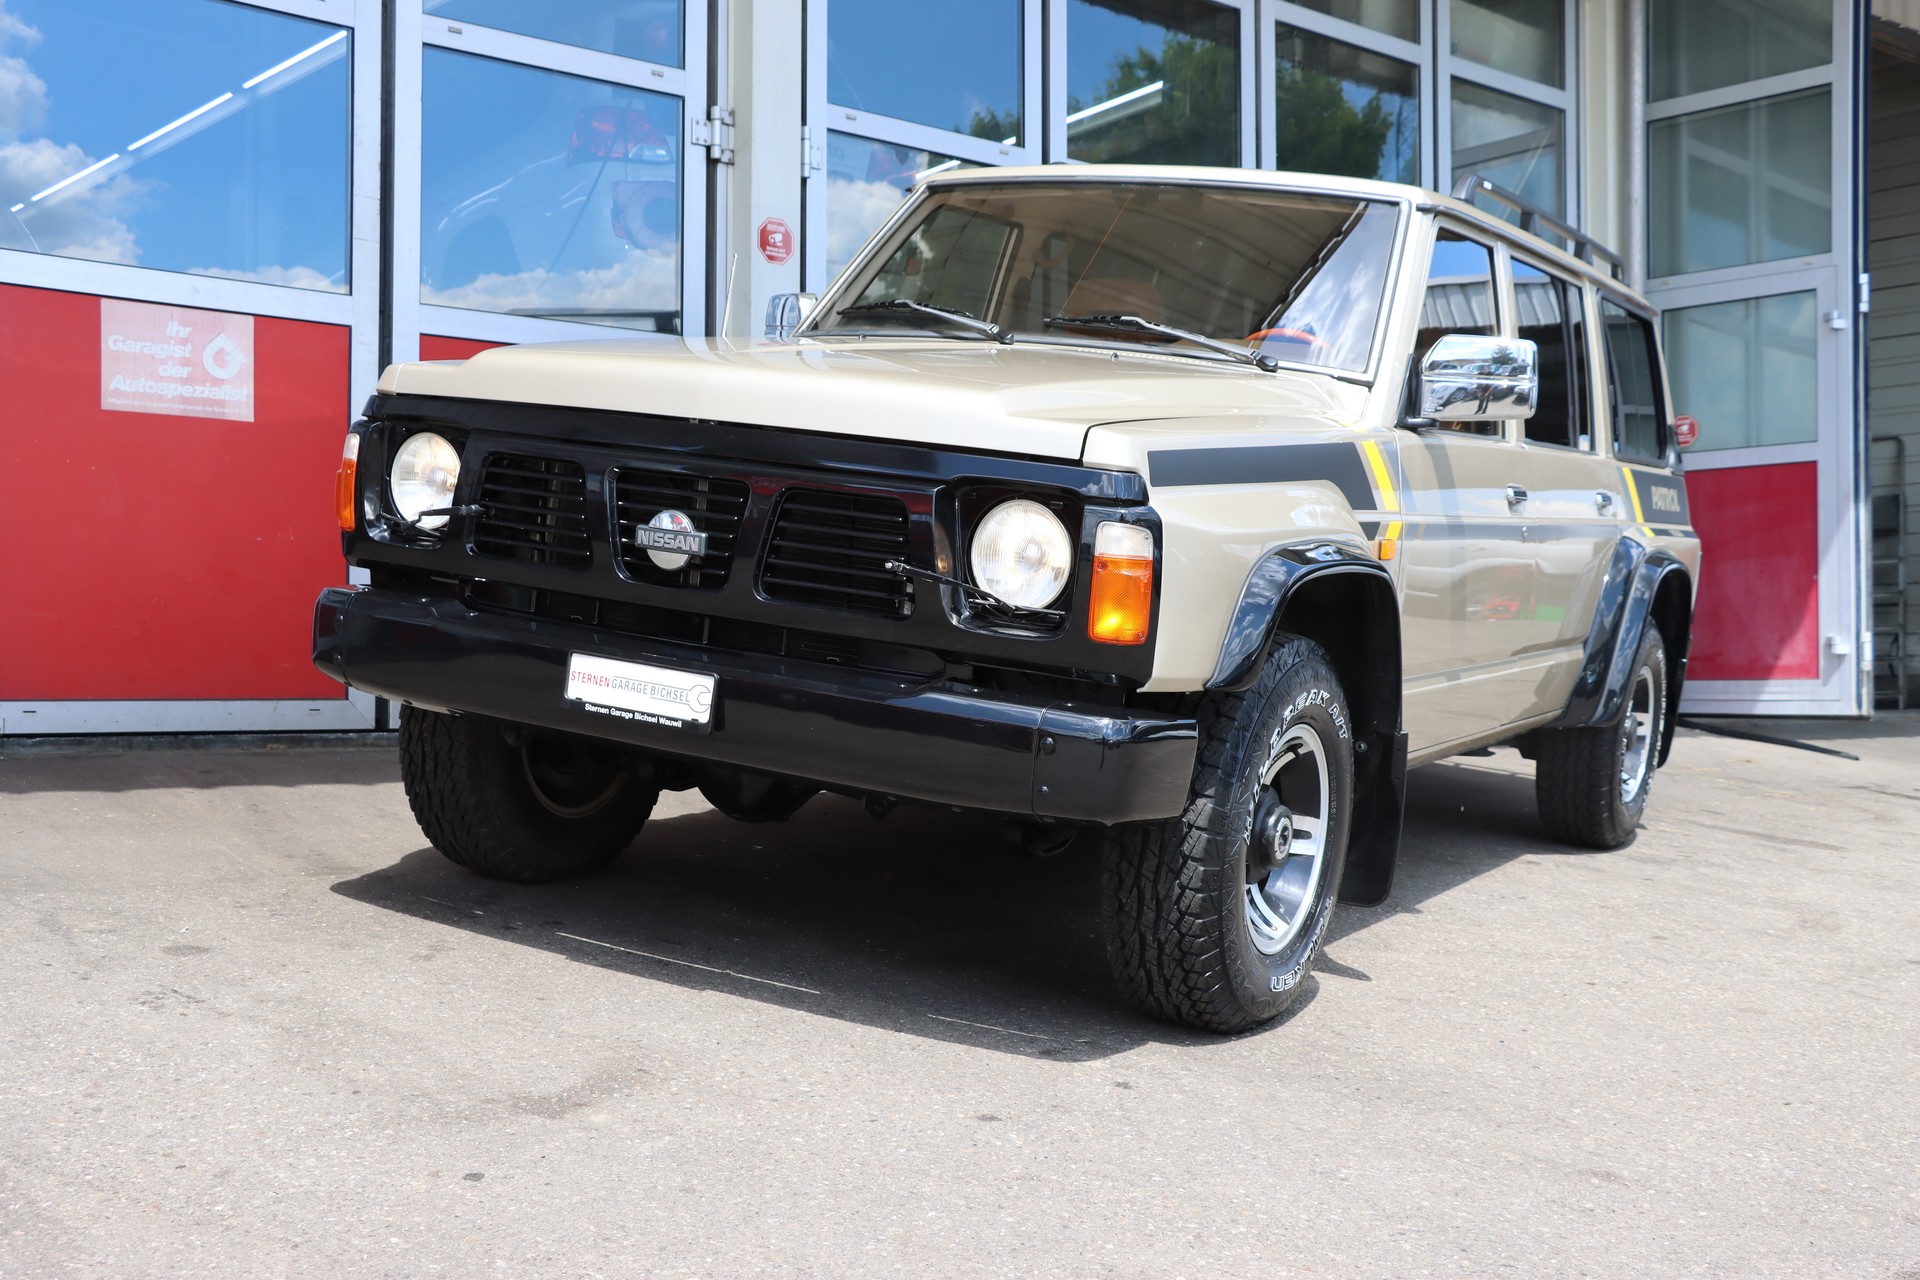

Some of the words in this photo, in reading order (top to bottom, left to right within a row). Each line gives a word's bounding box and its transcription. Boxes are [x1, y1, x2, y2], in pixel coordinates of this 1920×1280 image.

[166, 321, 192, 338] Ihr
[108, 335, 192, 359] Garagist
[158, 361, 192, 378] der
[109, 374, 249, 402] Autospezialist
[1651, 486, 1680, 512] PATROL
[637, 529, 700, 552] NISSAN
[571, 670, 610, 687] STERNEN
[612, 679, 649, 695] GARAGE
[650, 686, 690, 703] BICHSEL
[584, 703, 609, 715] Sternen
[610, 708, 633, 719] Garage
[634, 712, 658, 723] Bichsel
[659, 717, 682, 728] Wauwil
